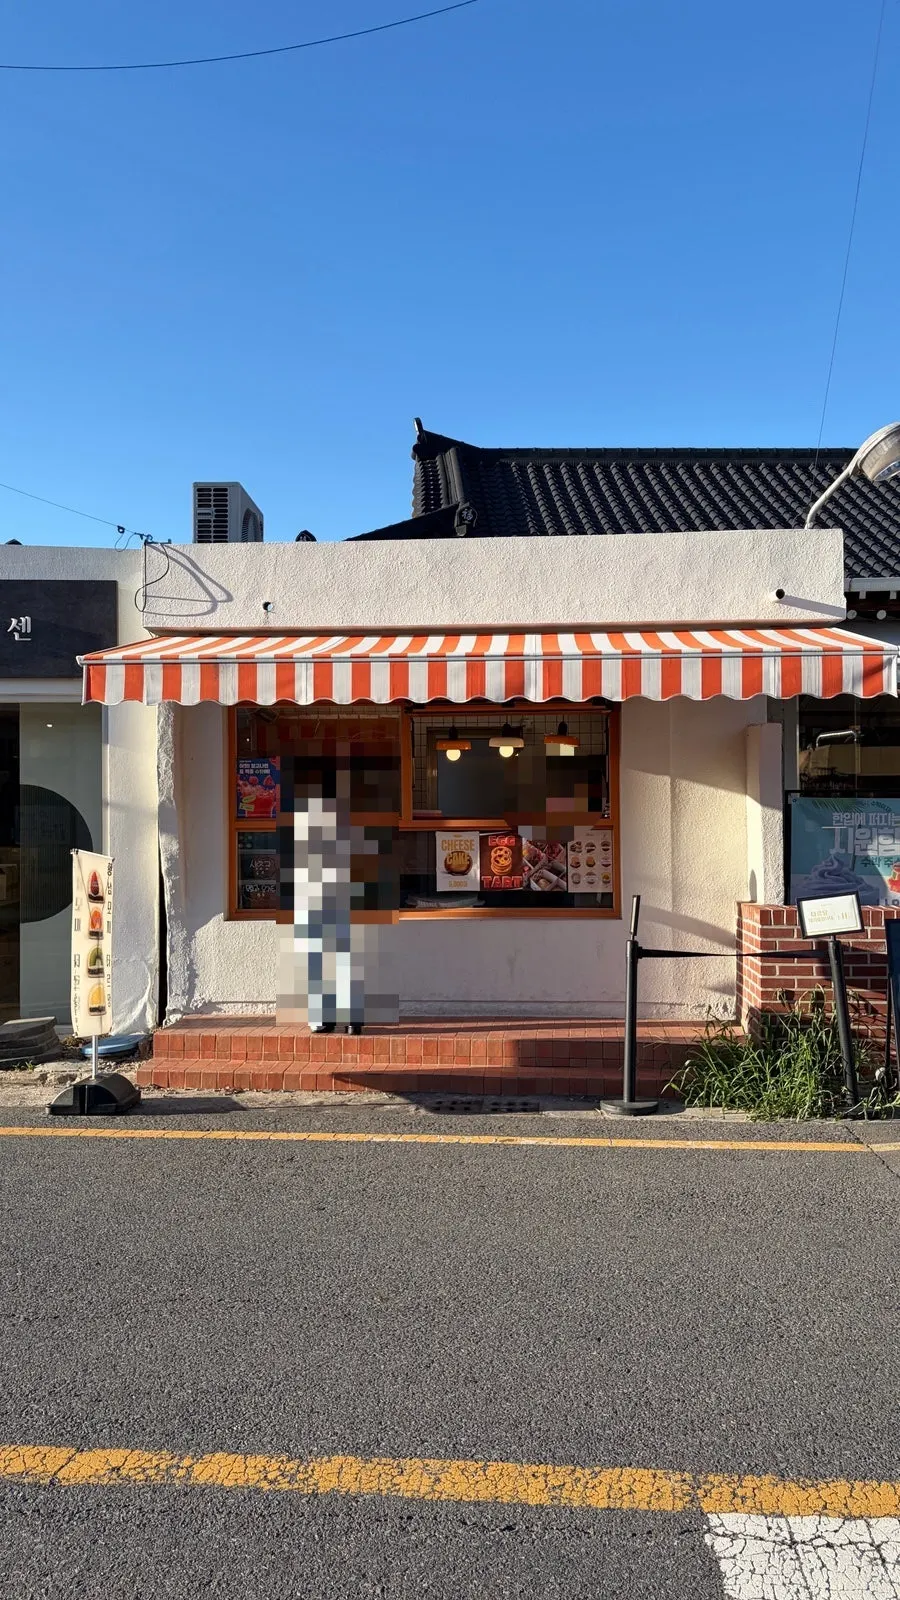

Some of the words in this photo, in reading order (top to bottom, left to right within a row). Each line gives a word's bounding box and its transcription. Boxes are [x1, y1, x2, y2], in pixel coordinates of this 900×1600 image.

[7, 616, 32, 641] 센
[831, 812, 866, 826] 한입에
[441, 839, 475, 852] CHEESE
[488, 835, 516, 847] EGG
[446, 852, 471, 865] CAKE
[481, 875, 523, 889] TART
